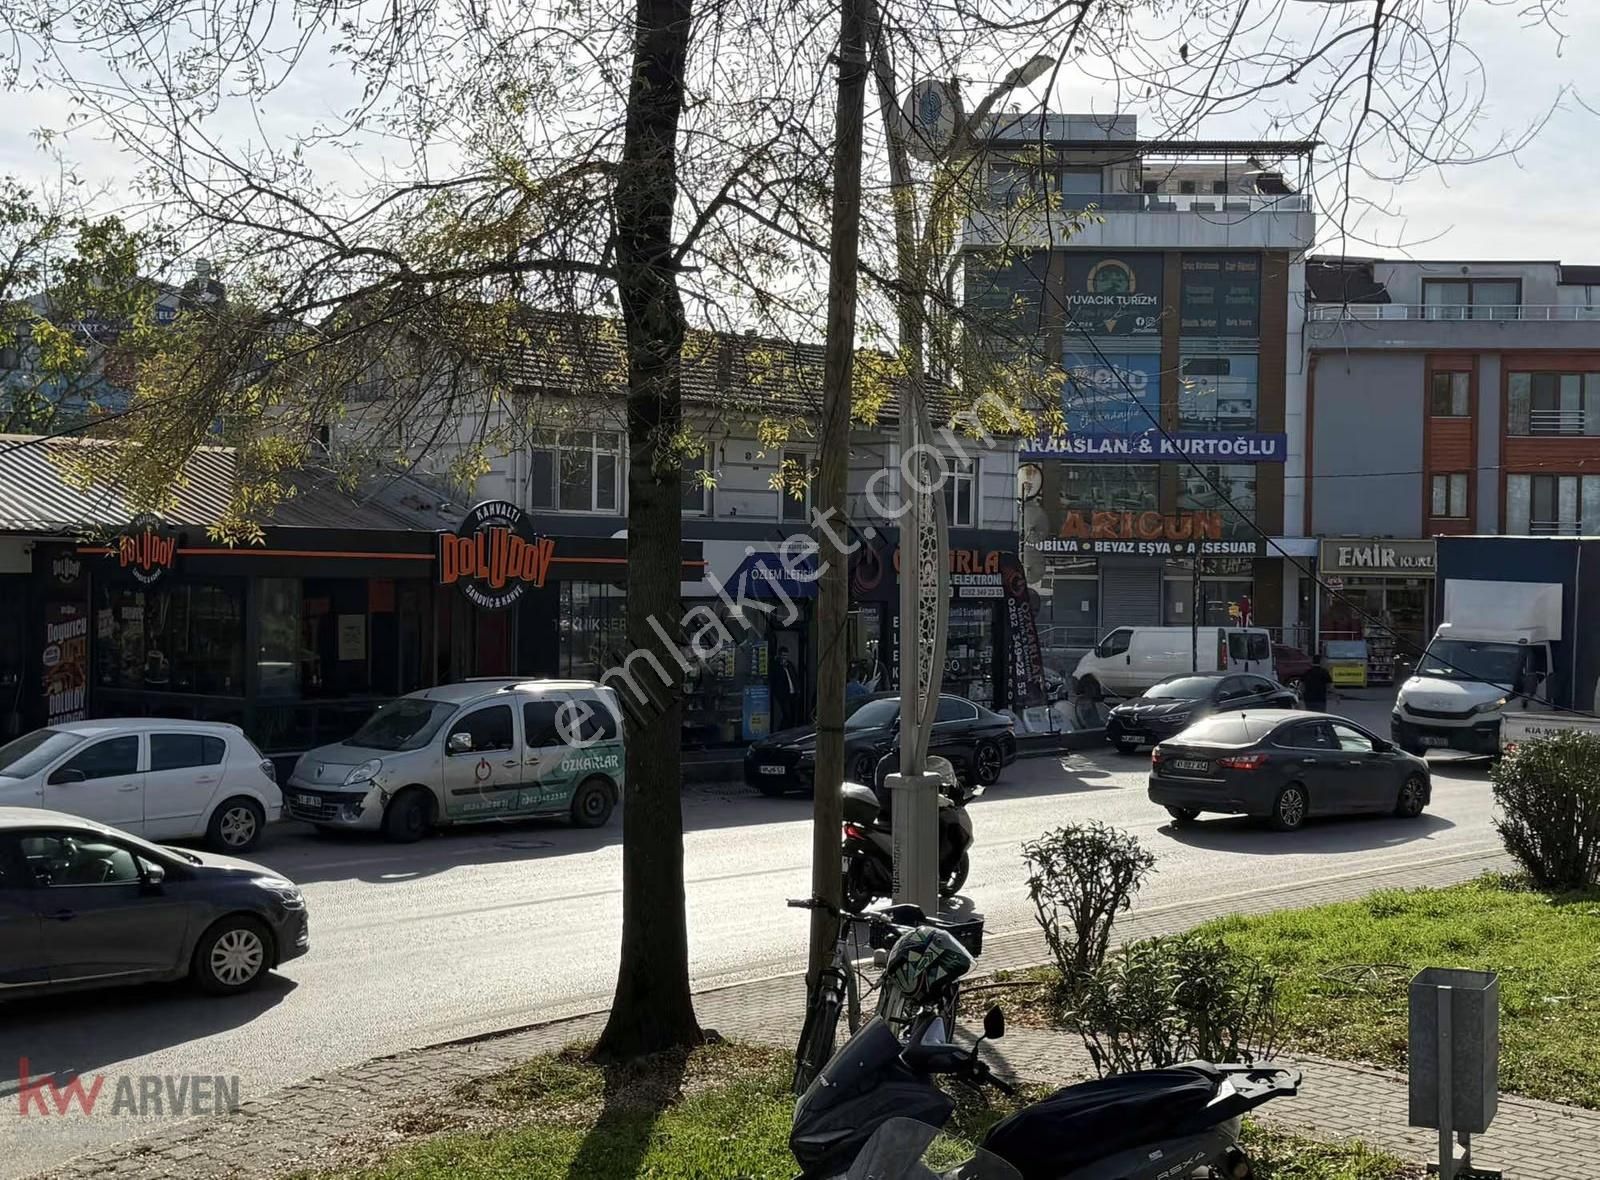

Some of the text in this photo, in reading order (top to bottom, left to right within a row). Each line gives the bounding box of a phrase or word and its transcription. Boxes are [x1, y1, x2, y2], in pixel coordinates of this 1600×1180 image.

[1066, 295, 1114, 305] YUVACIK
[1138, 439, 1153, 454] &
[1160, 436, 1276, 455] KURTOĞLU
[475, 503, 521, 523] KAHVALTI
[1094, 542, 1135, 553] BEYAZ
[1139, 542, 1171, 556] EŞYA
[1338, 544, 1397, 567] EMİR
[501, 584, 524, 606] KAHVE
[1008, 597, 1019, 628] 0262
[1017, 681, 1027, 696] 53
